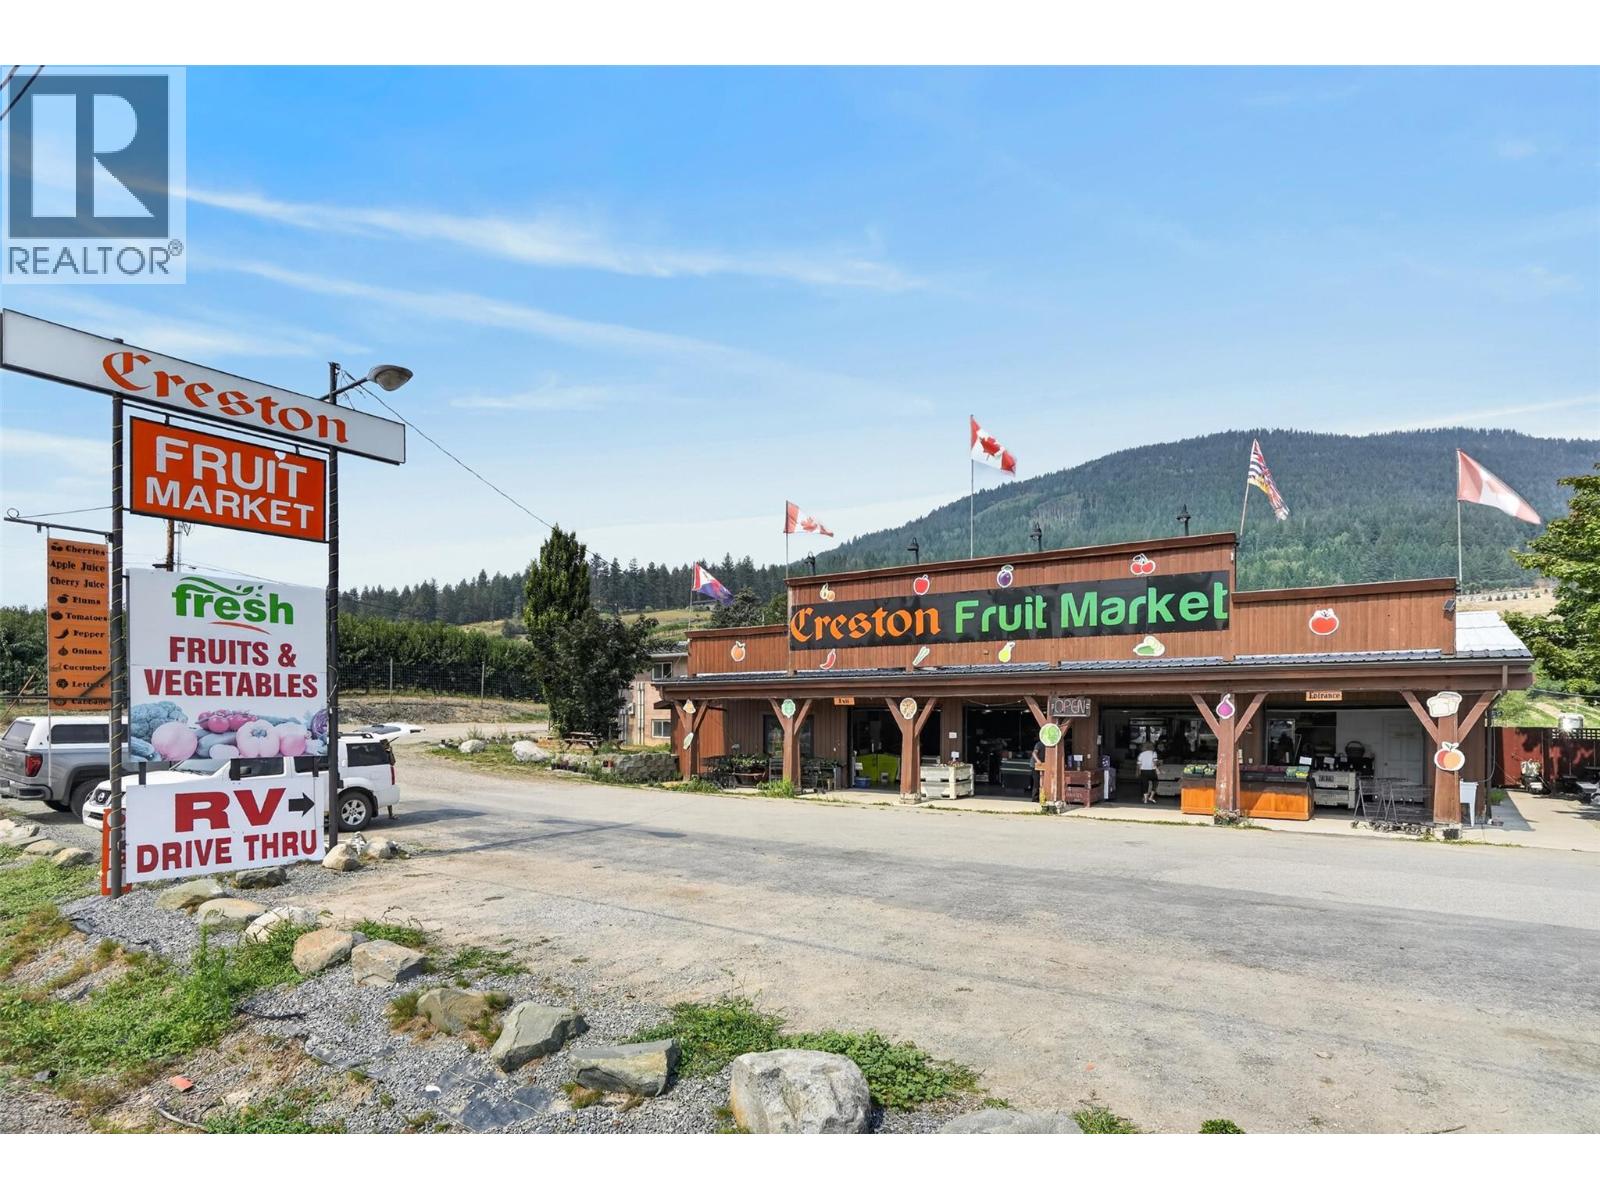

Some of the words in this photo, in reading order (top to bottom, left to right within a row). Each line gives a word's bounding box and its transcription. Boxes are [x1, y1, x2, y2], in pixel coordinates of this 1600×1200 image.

[103, 351, 348, 444] Creston
[155, 435, 307, 498] FRUIT
[146, 476, 314, 529] MARKET
[65, 544, 105, 556] Cherries
[50, 560, 76, 570] Apple
[81, 561, 105, 572] Juice
[50, 576, 80, 588] Cherry
[84, 579, 105, 589] Juice
[72, 596, 101, 605] Plums
[172, 580, 294, 625] fresh
[790, 606, 942, 643] Creston
[955, 595, 1048, 634] Fruit
[1061, 581, 1229, 629] Market
[65, 612, 108, 621] Tomatoes
[73, 629, 106, 638] Pepper
[72, 647, 103, 655] Onions
[169, 636, 269, 667] FRUITS
[277, 643, 297, 668] &
[144, 668, 318, 698] VEGETABLES
[1055, 699, 1086, 714] OPEN
[175, 787, 286, 833] RV
[136, 837, 232, 874] DRIVE
[243, 829, 317, 862] THRU
